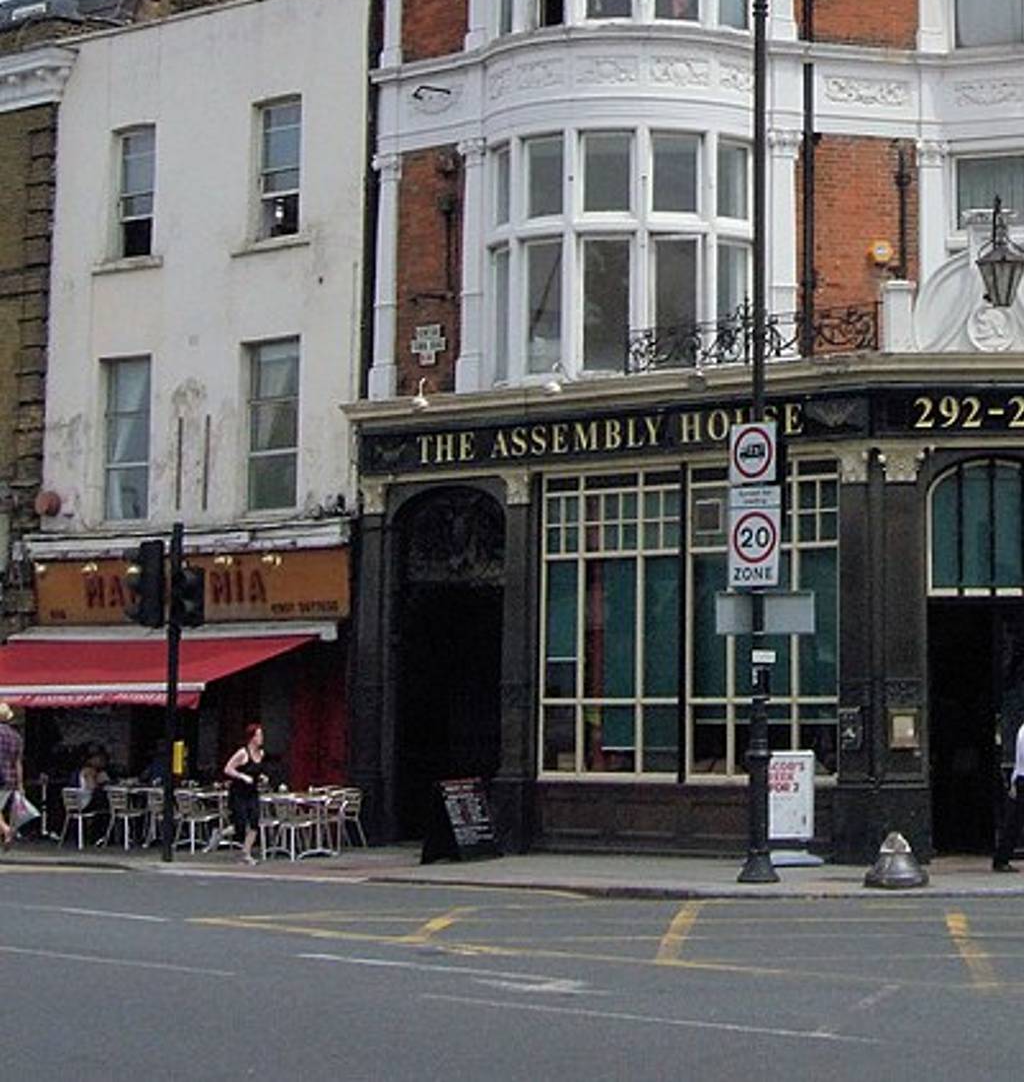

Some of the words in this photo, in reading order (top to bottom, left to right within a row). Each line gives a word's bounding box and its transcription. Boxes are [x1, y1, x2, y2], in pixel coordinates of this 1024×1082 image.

[417, 431, 475, 464] THE
[490, 416, 662, 458] ASSEMBLY
[740, 527, 770, 548] 20
[734, 567, 773, 581] ZONE
